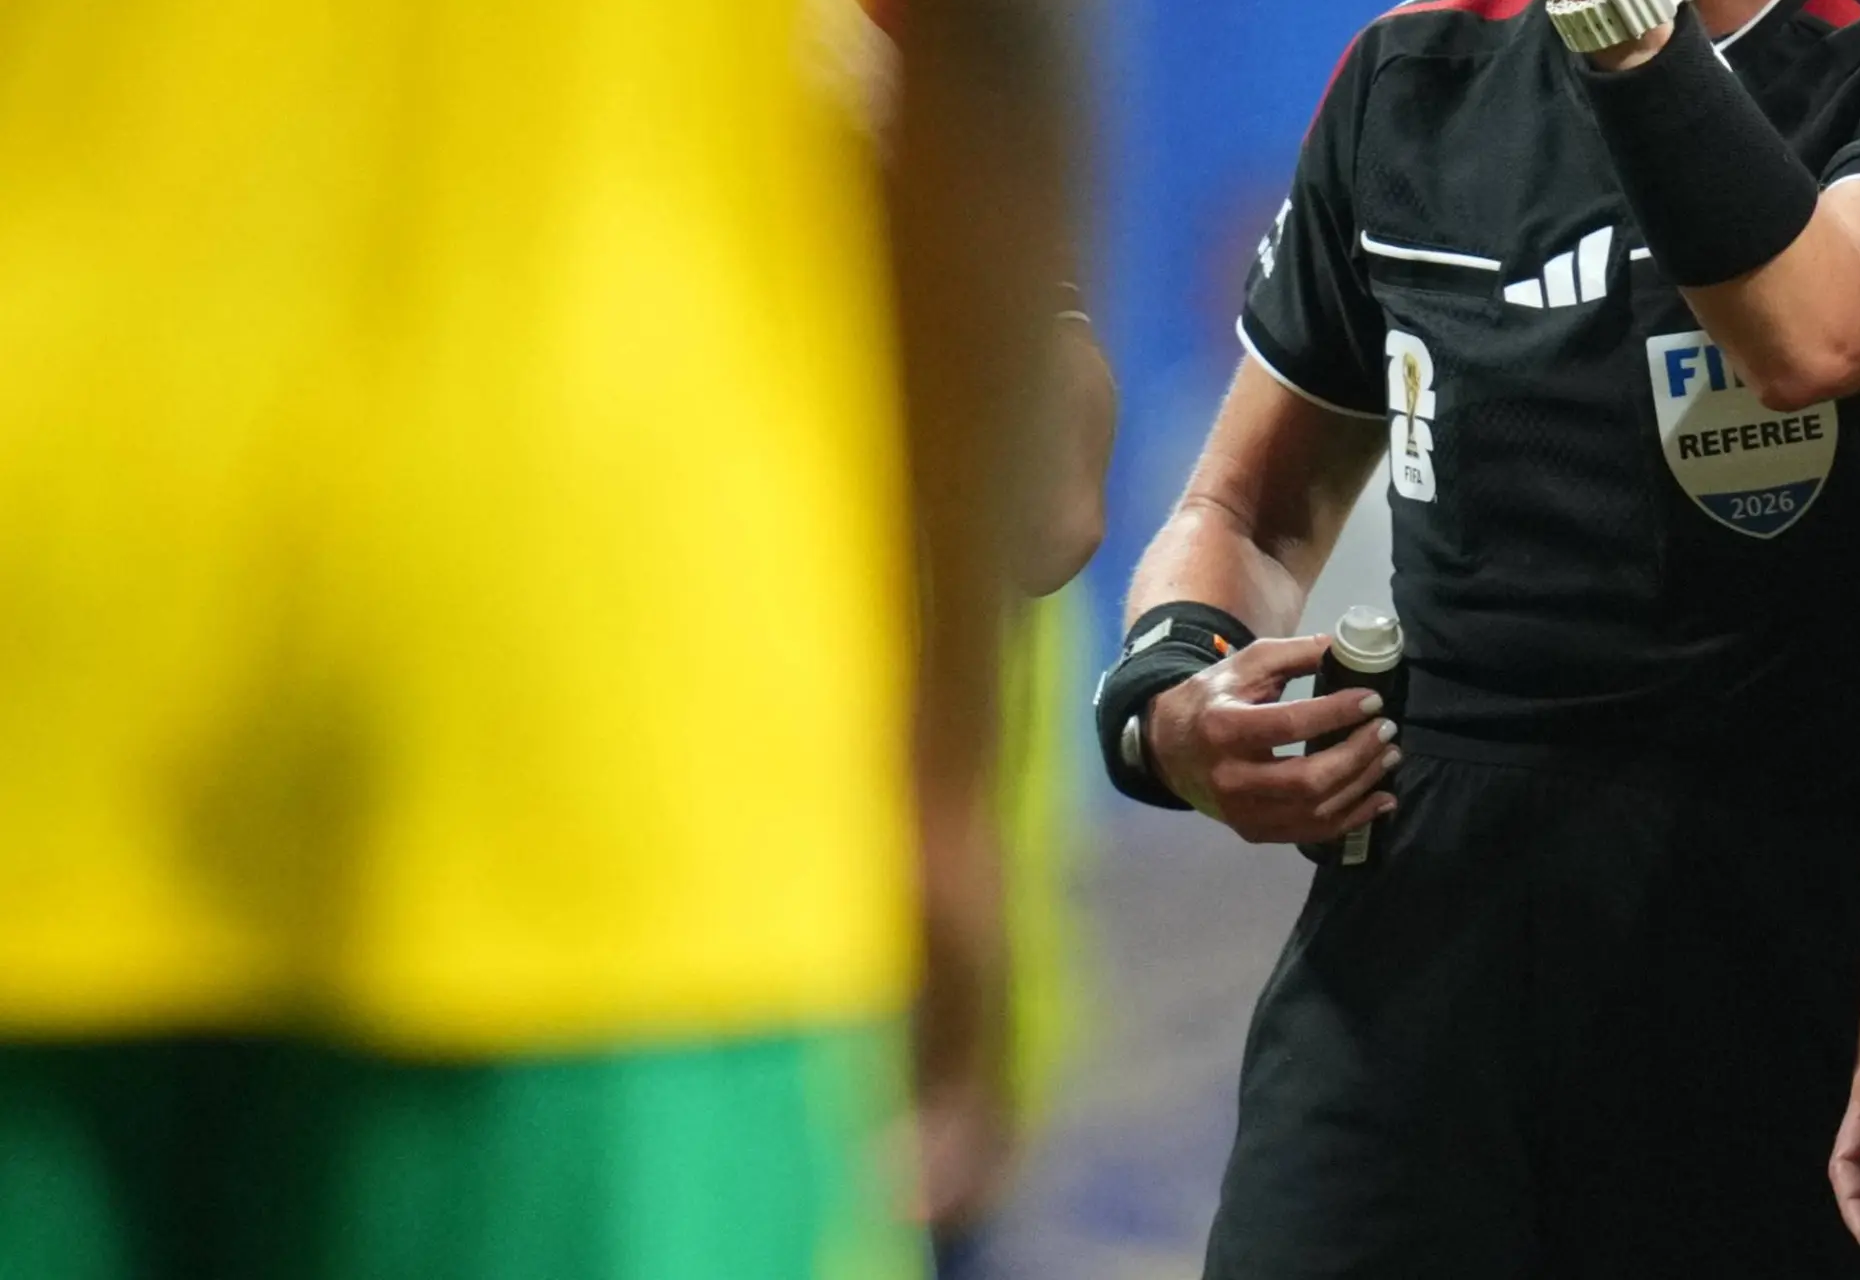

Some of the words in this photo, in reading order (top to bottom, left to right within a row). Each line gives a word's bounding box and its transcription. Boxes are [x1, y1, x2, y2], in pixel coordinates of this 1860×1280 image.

[1664, 343, 1746, 398] FI
[1677, 413, 1824, 461] REFEREE
[1404, 464, 1424, 486] FIFA
[1729, 490, 1795, 520] 2026
